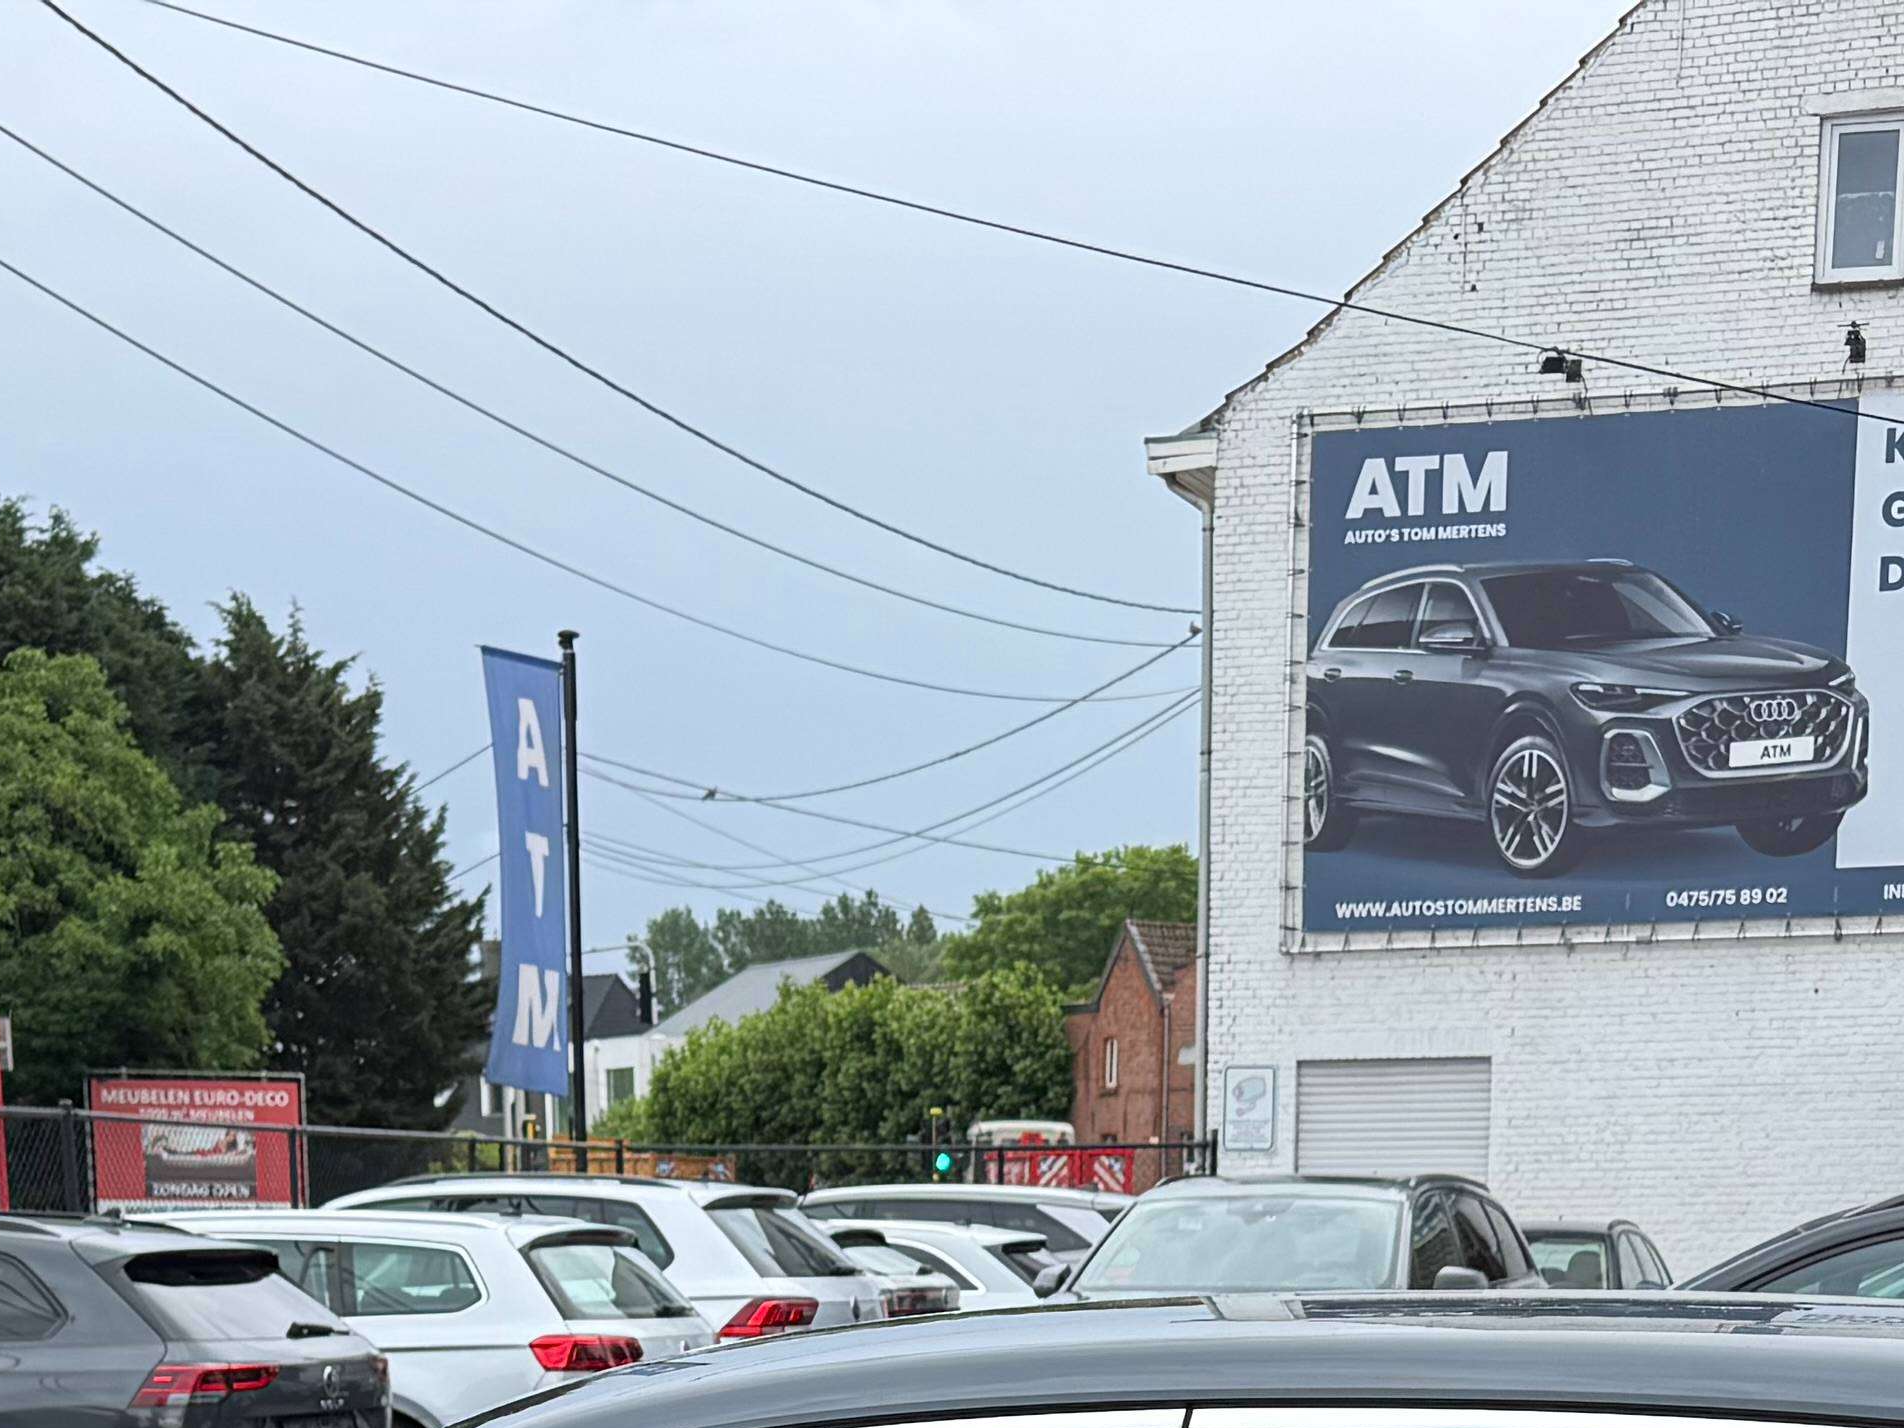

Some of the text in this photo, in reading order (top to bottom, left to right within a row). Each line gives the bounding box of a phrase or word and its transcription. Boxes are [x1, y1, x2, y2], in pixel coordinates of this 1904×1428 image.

[1345, 451, 1508, 519] ATM
[1344, 523, 1507, 544] AUTO'S TOM MERTENS
[1760, 743, 1792, 760] ATM
[512, 698, 562, 1052] ATM
[1335, 895, 1583, 919] WWW.AUTOSTOMMERTENS.BE
[1665, 887, 1788, 908] 0475/75 89 02
[100, 1087, 290, 1107] MEUBELEN EURO-DECO
